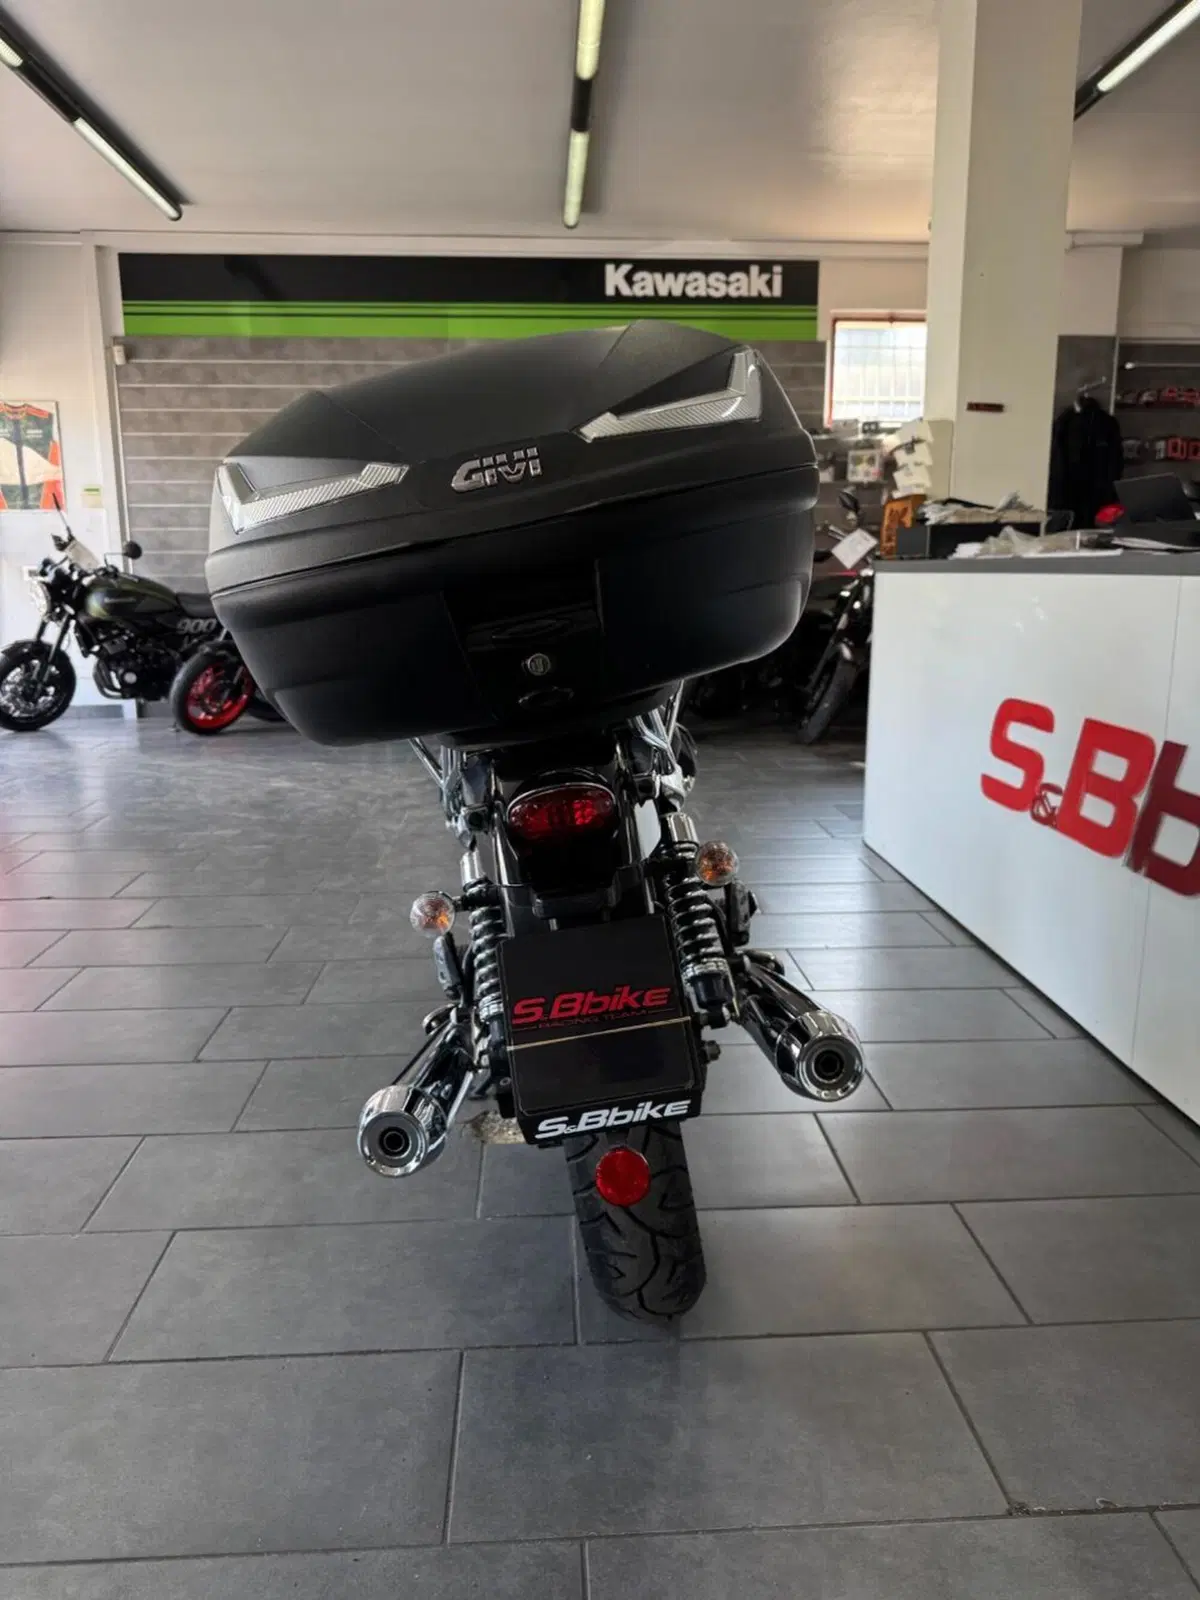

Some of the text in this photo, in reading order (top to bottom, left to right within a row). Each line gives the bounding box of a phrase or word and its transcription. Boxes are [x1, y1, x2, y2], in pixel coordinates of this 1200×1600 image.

[605, 264, 783, 297] Kawasaki
[451, 447, 542, 493] GIVI
[177, 618, 217, 635] 900
